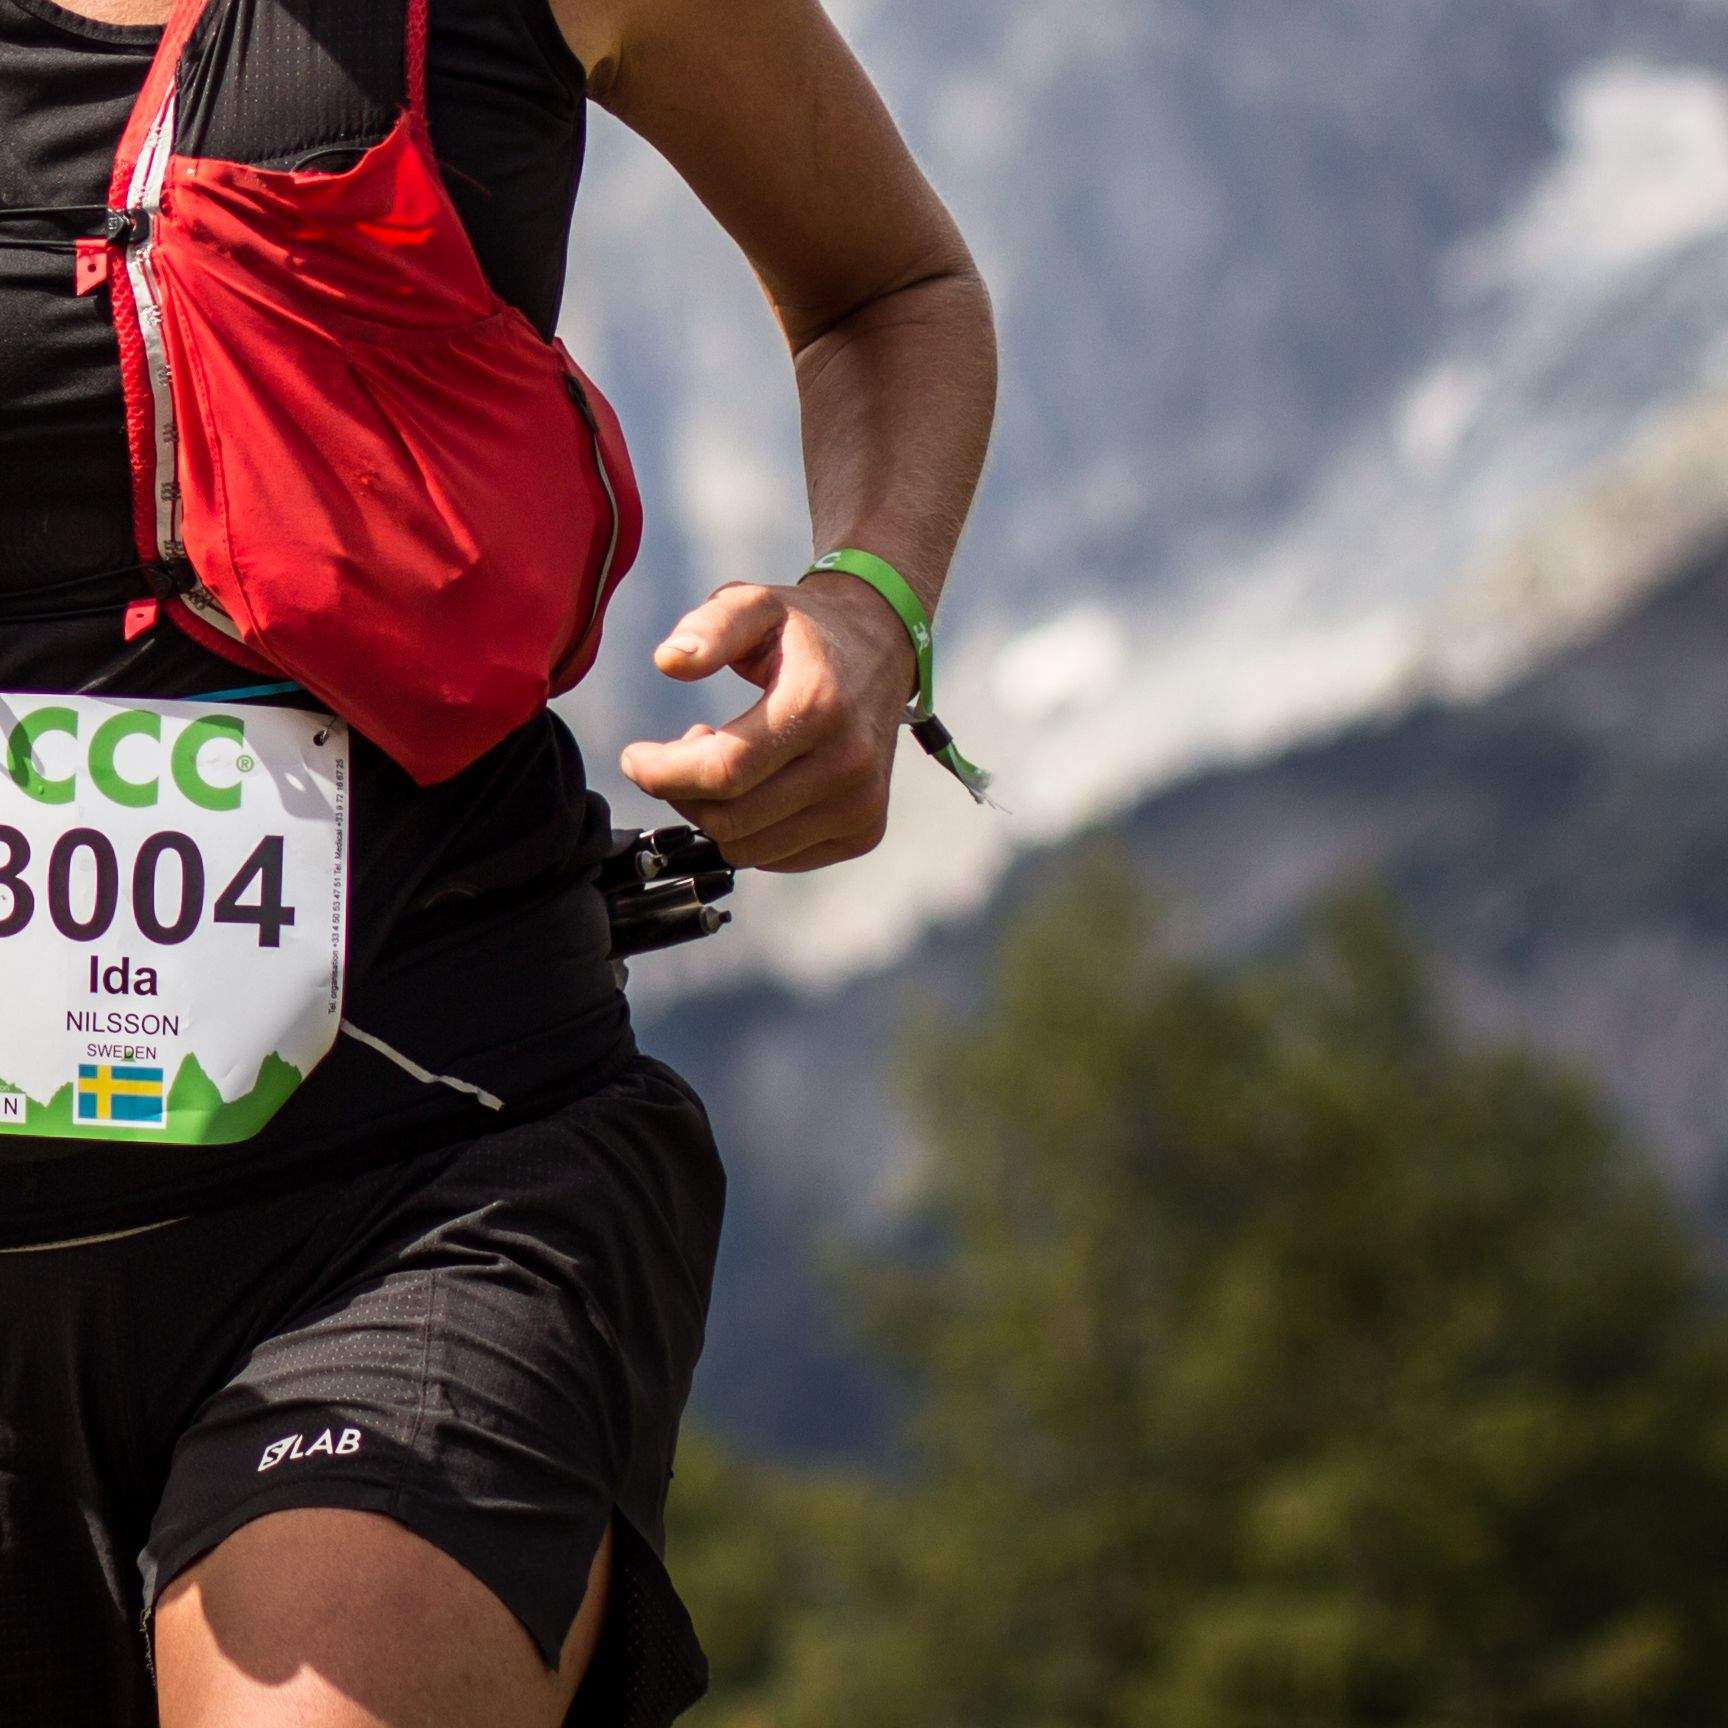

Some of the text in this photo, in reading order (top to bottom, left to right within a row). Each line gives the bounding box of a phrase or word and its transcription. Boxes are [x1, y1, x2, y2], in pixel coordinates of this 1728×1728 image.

[6, 706, 245, 812] CCC
[89, 955, 158, 996] Ida
[66, 1010, 179, 1036] NILSSON
[86, 1043, 157, 1060] SWEDEN
[4, 1097, 18, 1116] N
